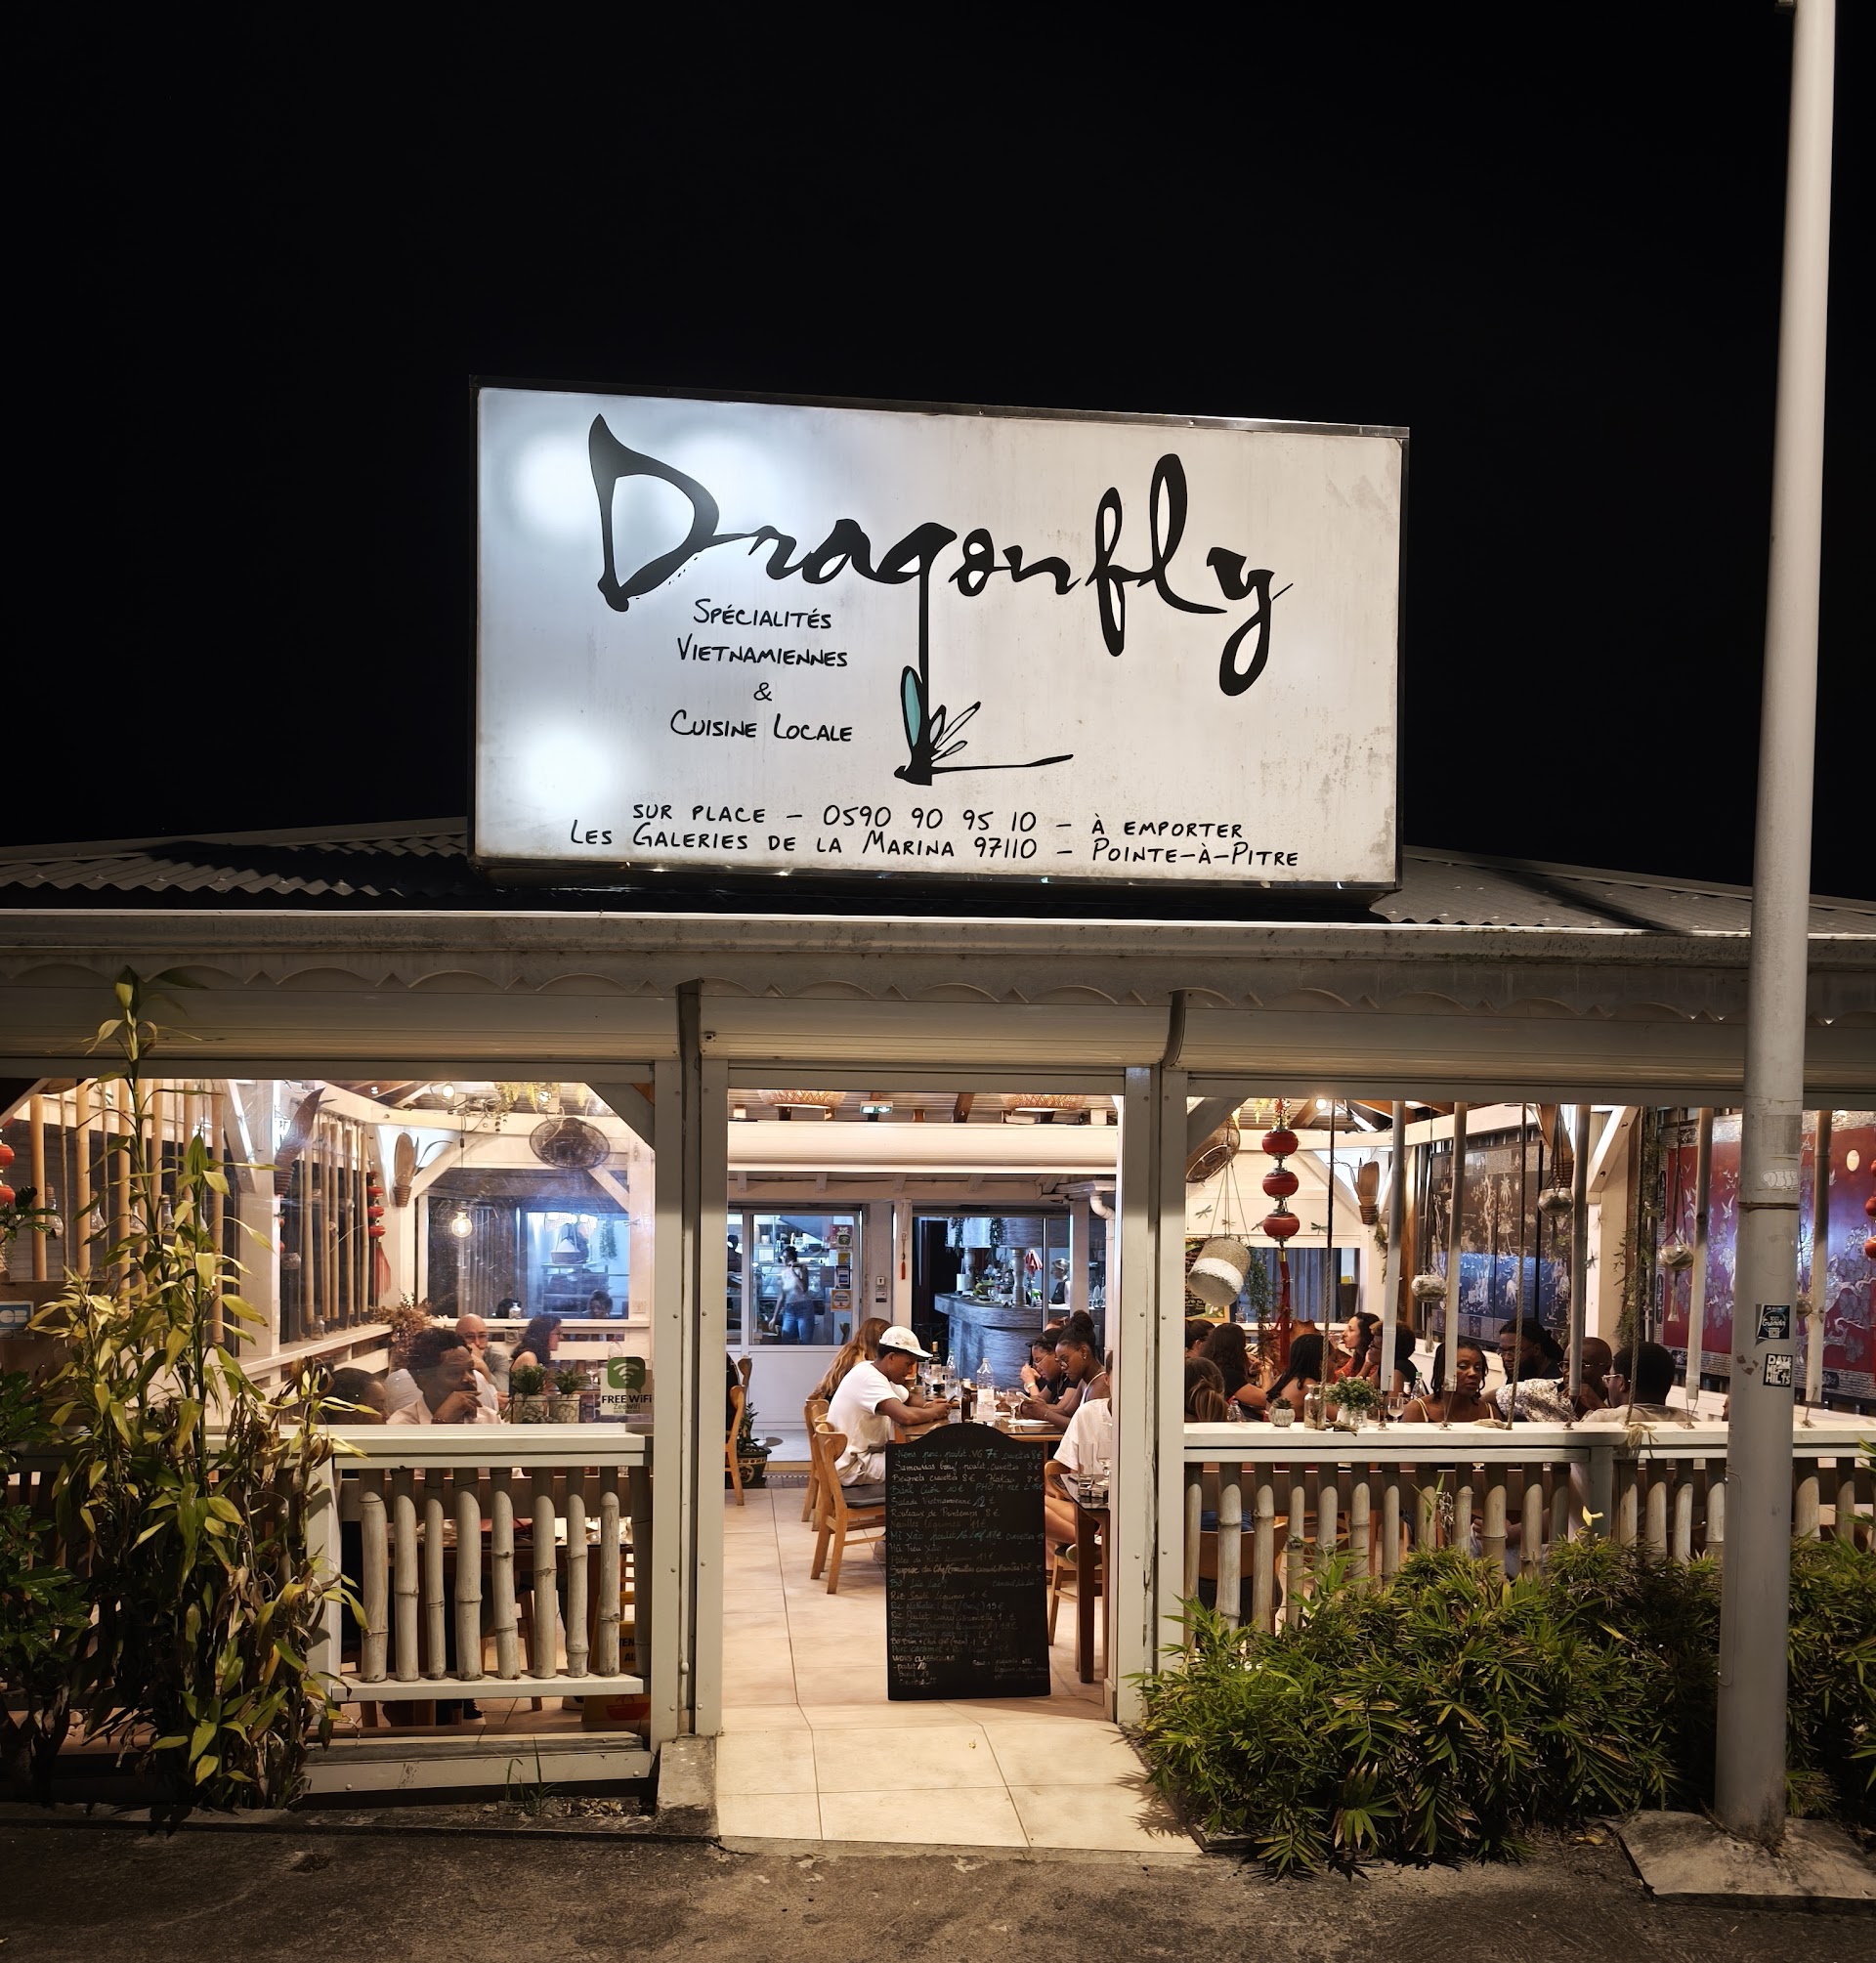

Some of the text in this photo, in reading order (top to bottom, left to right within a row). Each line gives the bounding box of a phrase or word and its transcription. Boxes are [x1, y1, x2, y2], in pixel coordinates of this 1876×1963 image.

[589, 413, 1293, 696] Dragonfly
[694, 599, 831, 628] SPÉCIALITÉS
[677, 633, 847, 666] VIETNAMIENNES
[753, 682, 772, 701] &
[670, 709, 852, 742] CUISINE LOCALE
[633, 804, 671, 819] SUR
[693, 805, 765, 823] PLACE
[824, 805, 891, 827] 0590
[912, 808, 942, 829] 90
[963, 810, 993, 831] 95
[1012, 812, 1036, 832] 10
[1092, 813, 1104, 834] À
[1125, 822, 1242, 837] EMPORTER
[572, 820, 612, 844] LES
[633, 822, 747, 849] GALERIES
[768, 835, 795, 851] DE
[817, 838, 841, 853] LA
[863, 831, 954, 856] MARINA
[974, 837, 1037, 858] 97110
[1093, 838, 1298, 866] POINTE-À-PITRE
[602, 1394, 652, 1403] FREE WiFi
